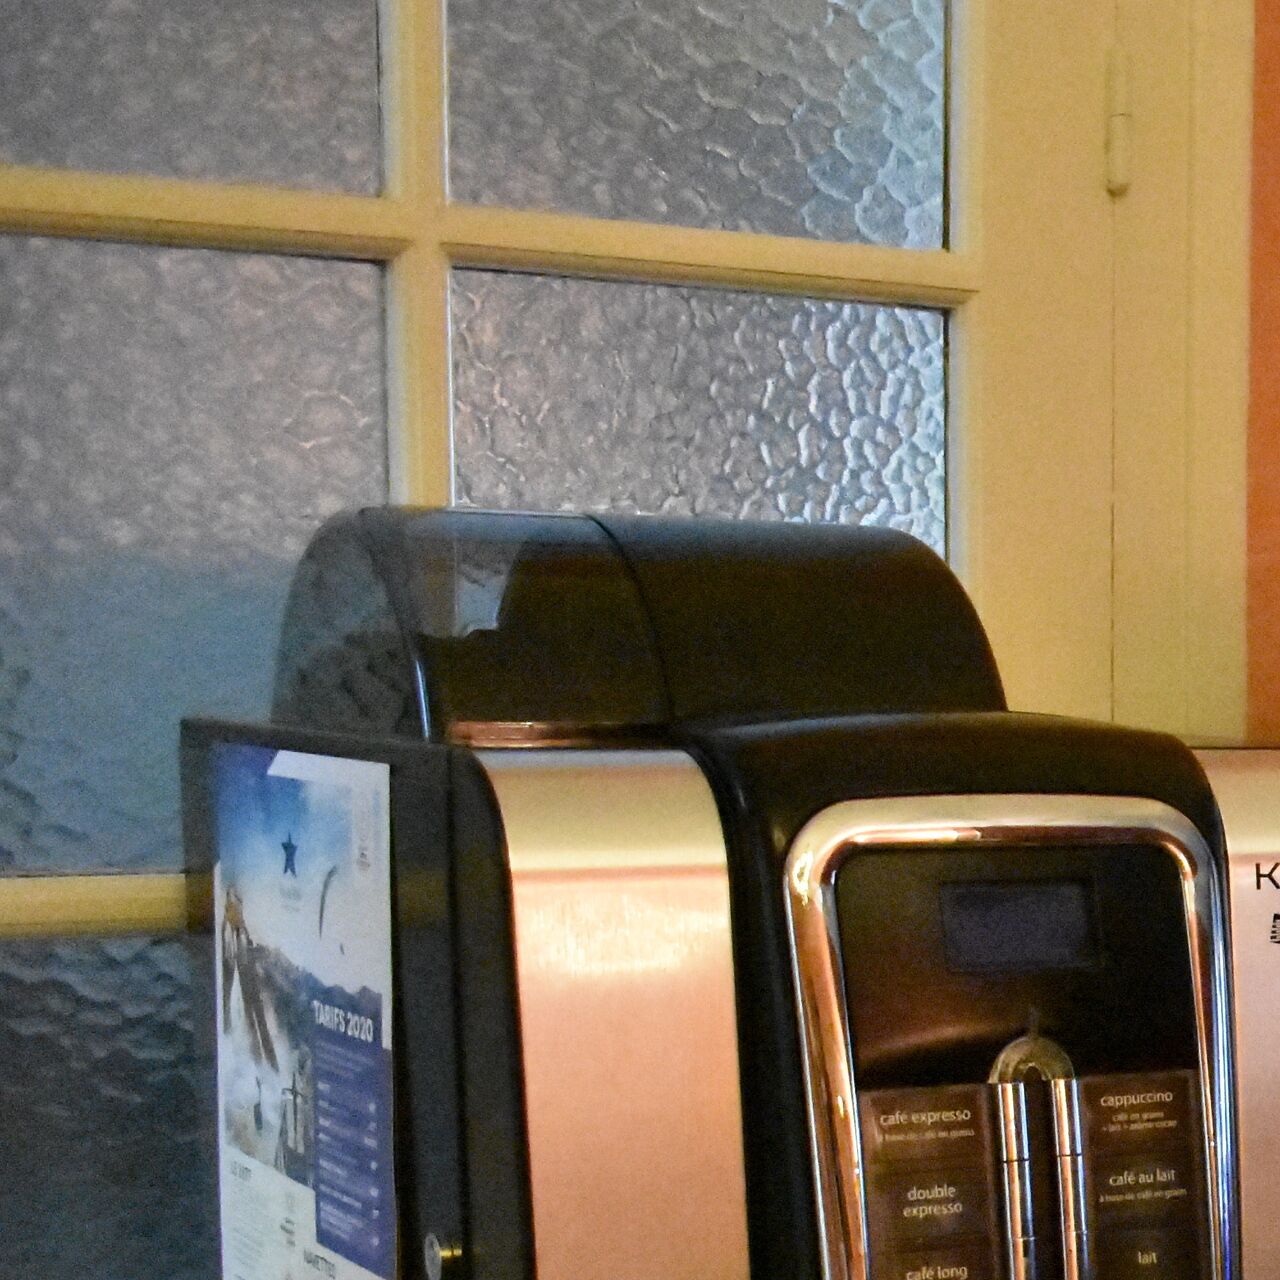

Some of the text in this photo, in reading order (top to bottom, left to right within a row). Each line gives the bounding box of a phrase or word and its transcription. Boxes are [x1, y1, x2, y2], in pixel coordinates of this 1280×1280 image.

[311, 1000, 374, 1043] TARIFS 2020
[1100, 1091, 1174, 1108] cappuccino
[911, 1109, 972, 1126] expresso
[1109, 1168, 1176, 1187] café au lait
[907, 1184, 957, 1201] double
[902, 1202, 963, 1219] expresso
[1138, 1252, 1157, 1264] lait
[937, 1266, 968, 1280] long
